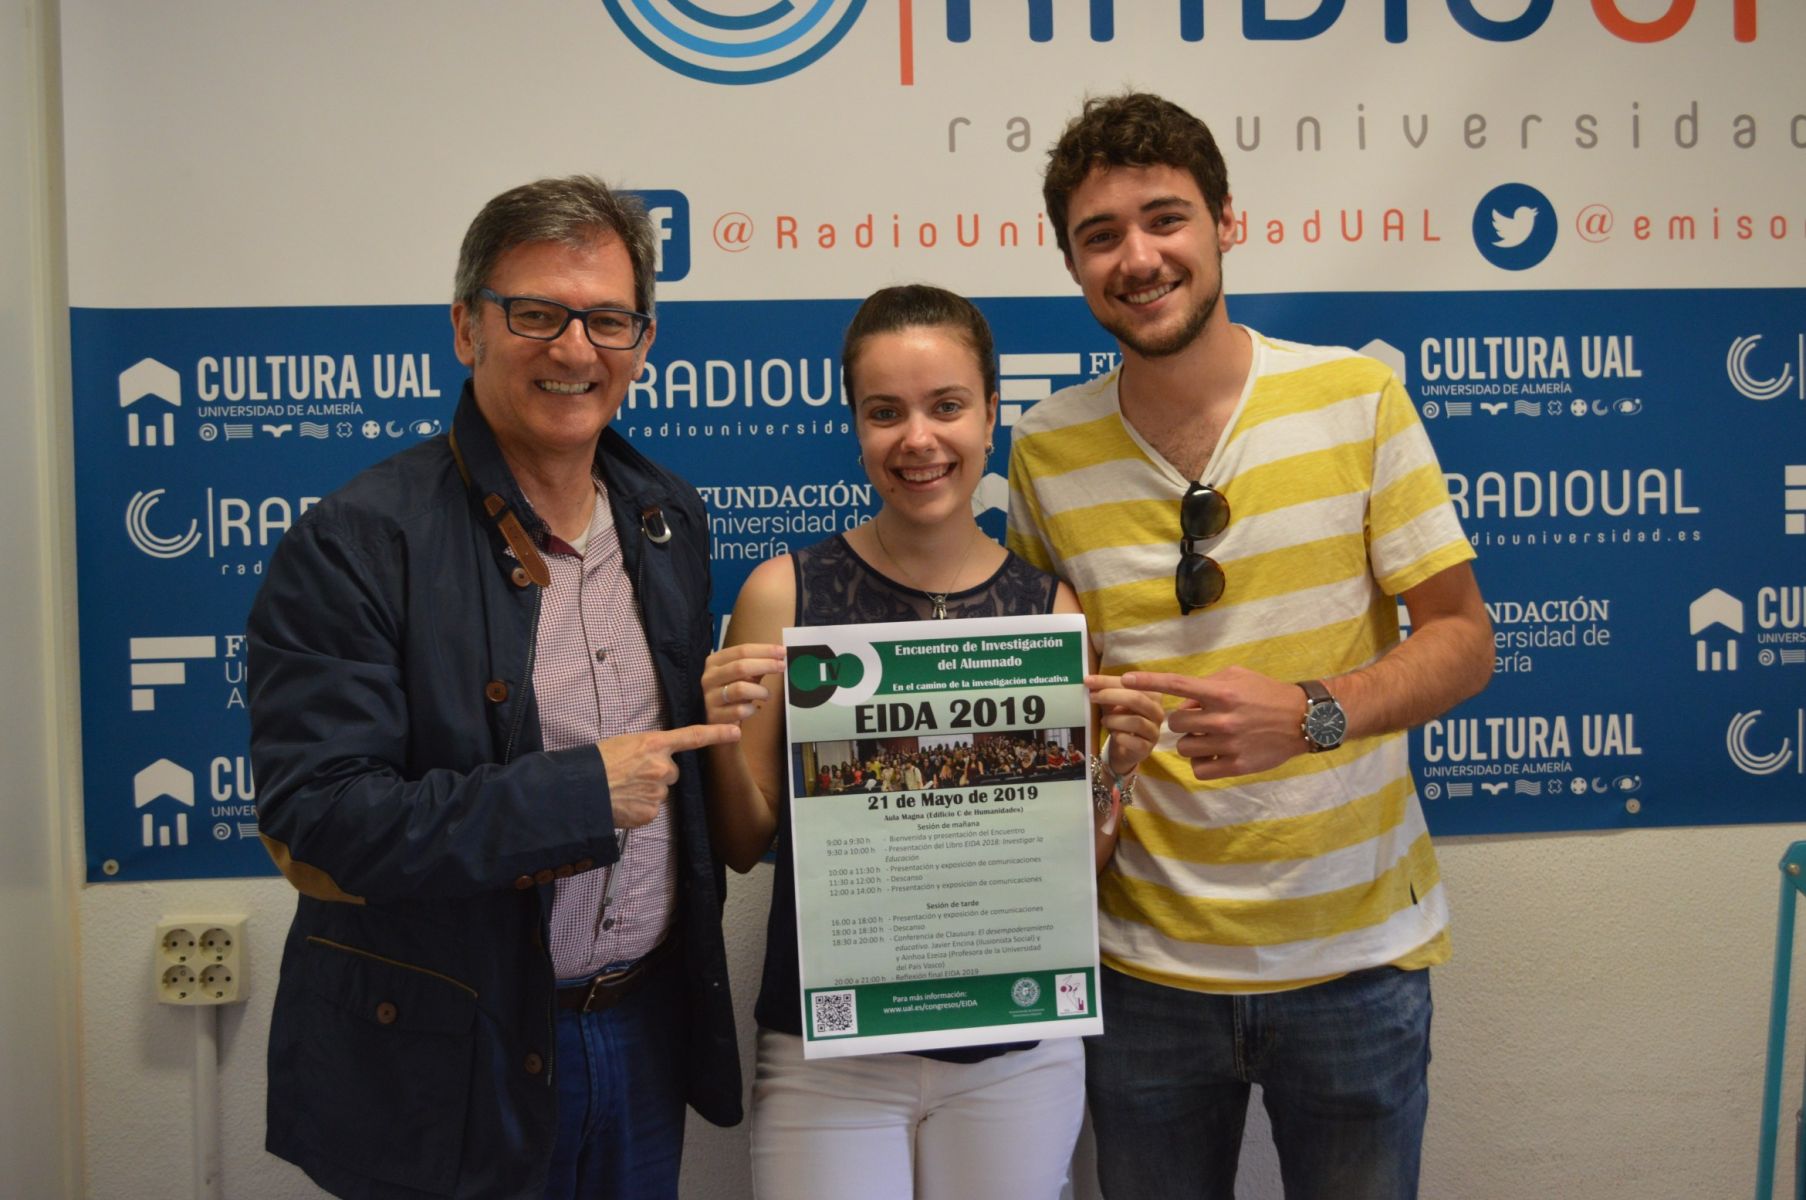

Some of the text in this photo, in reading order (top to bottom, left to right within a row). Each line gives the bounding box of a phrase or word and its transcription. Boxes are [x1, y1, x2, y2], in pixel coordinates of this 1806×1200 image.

[1575, 203, 1806, 243] @emiso
[1420, 335, 1642, 381] CULTURA UAL
[197, 354, 441, 402] CULTURA UAL
[628, 358, 848, 409] RADIOU
[1421, 380, 1573, 396] UNIVERSIDAD DE ALMERÍA
[198, 402, 364, 417] UNIVERSIDAD DE ALMERÍA
[1443, 468, 1701, 519] RADIOUAL
[708, 536, 789, 560] lmería
[1582, 623, 1611, 646] de
[895, 637, 1063, 656] Encuentro de Investigación
[937, 656, 1023, 671] del Alumnado
[892, 674, 1069, 692] En el camino de la investigación educativa
[855, 694, 1046, 734] EIDA 2019
[1423, 713, 1642, 762] CULTURA UAL
[1423, 759, 1573, 777] UNIVERSIDAD DE ALMERÍA
[868, 785, 1039, 810] 21 de Mayo de 2019
[901, 813, 924, 821] Magna
[926, 811, 955, 820] (Edificio
[974, 806, 1024, 816] Humanidades)
[917, 823, 940, 831] Sesión
[952, 820, 980, 828] mañana
[934, 830, 977, 840] presentación
[990, 828, 1025, 836] Encuentro
[889, 843, 932, 852] Presentación
[965, 840, 981, 848] EIDA
[890, 863, 934, 872] Presentación
[941, 859, 976, 869] exposición
[988, 856, 1042, 866] comunicaciones
[890, 874, 923, 882] Descanso
[891, 883, 935, 892] Presentación
[942, 879, 978, 889] exposición
[989, 876, 1042, 886] comunicaciones
[893, 912, 936, 922] Presentación
[943, 909, 979, 919] exposición
[990, 905, 1043, 915] comunicaciones
[926, 901, 949, 910] Sesión
[893, 924, 925, 932] Descanso
[894, 933, 934, 942] Conferencia
[931, 941, 951, 949] Javier
[952, 939, 975, 947] Encina
[1002, 944, 1041, 953] Universidad
[896, 971, 927, 981] Reflexión
[928, 970, 943, 978] final
[944, 969, 960, 977] EIDA
[892, 991, 968, 1003] Para más información:
